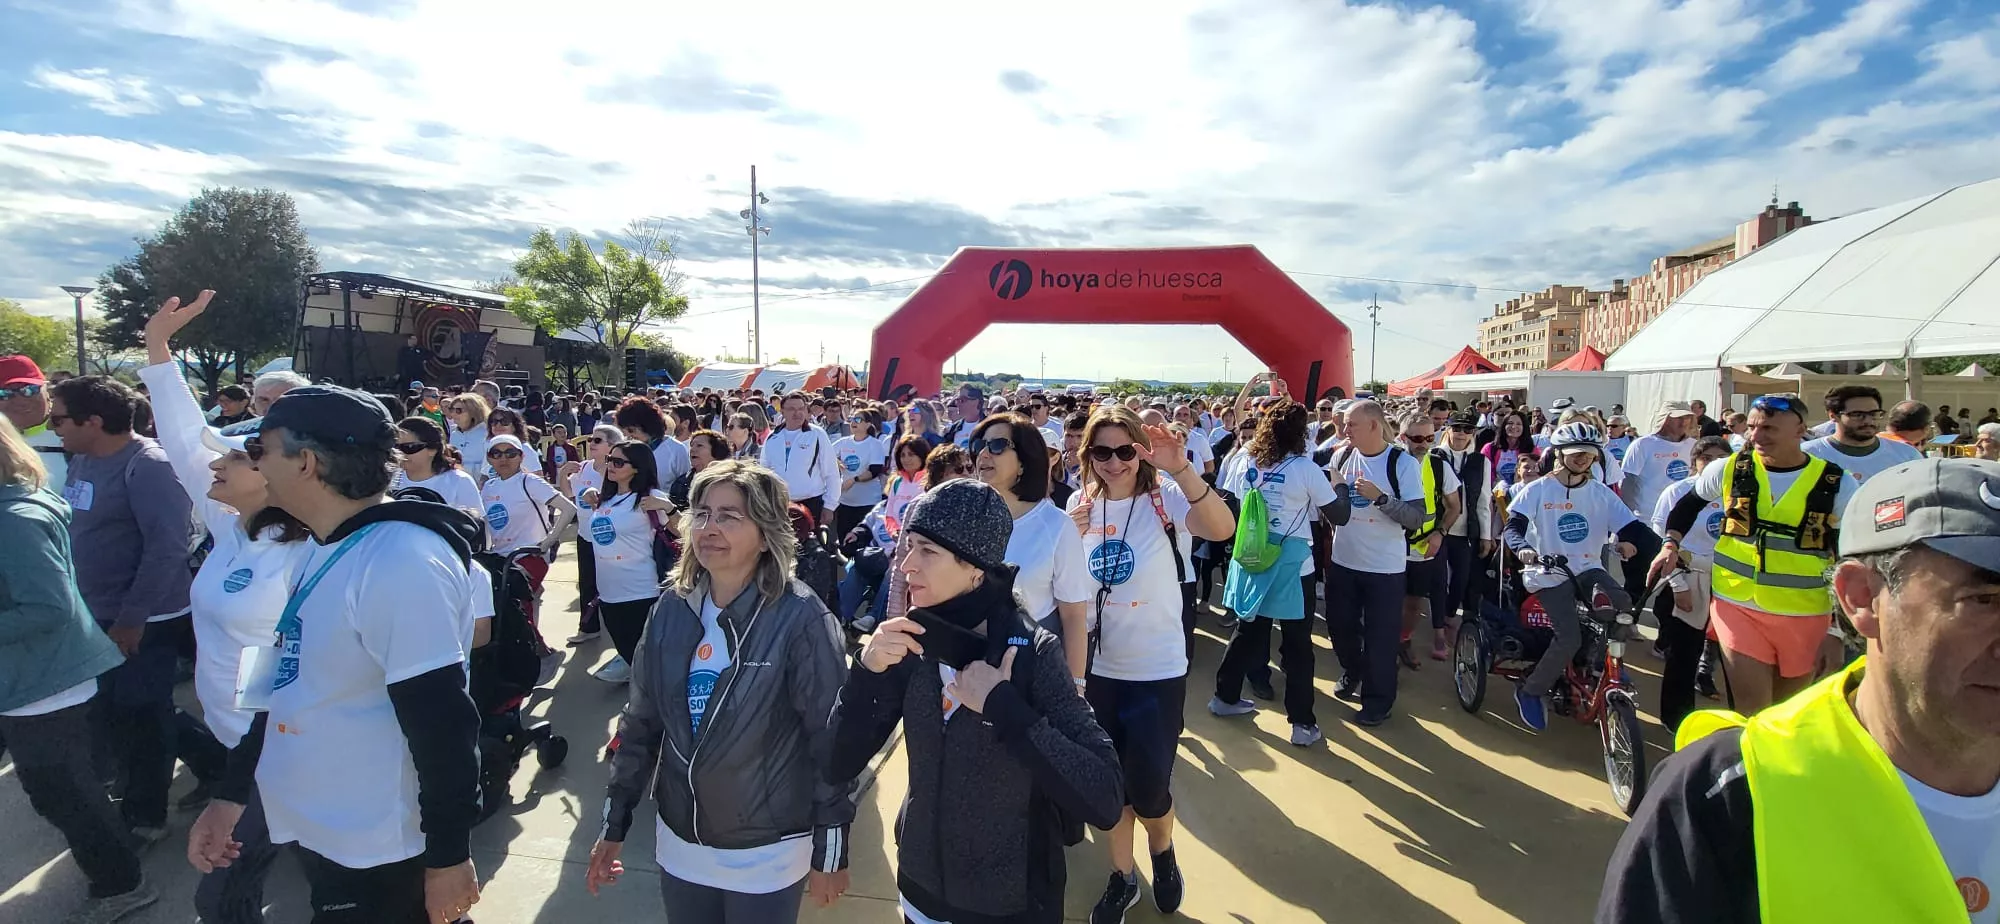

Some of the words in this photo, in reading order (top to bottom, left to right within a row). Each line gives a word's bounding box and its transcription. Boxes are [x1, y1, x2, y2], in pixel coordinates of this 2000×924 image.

[1040, 268, 1099, 293] hoya
[1104, 269, 1133, 288] de
[1138, 268, 1222, 288] huesca
